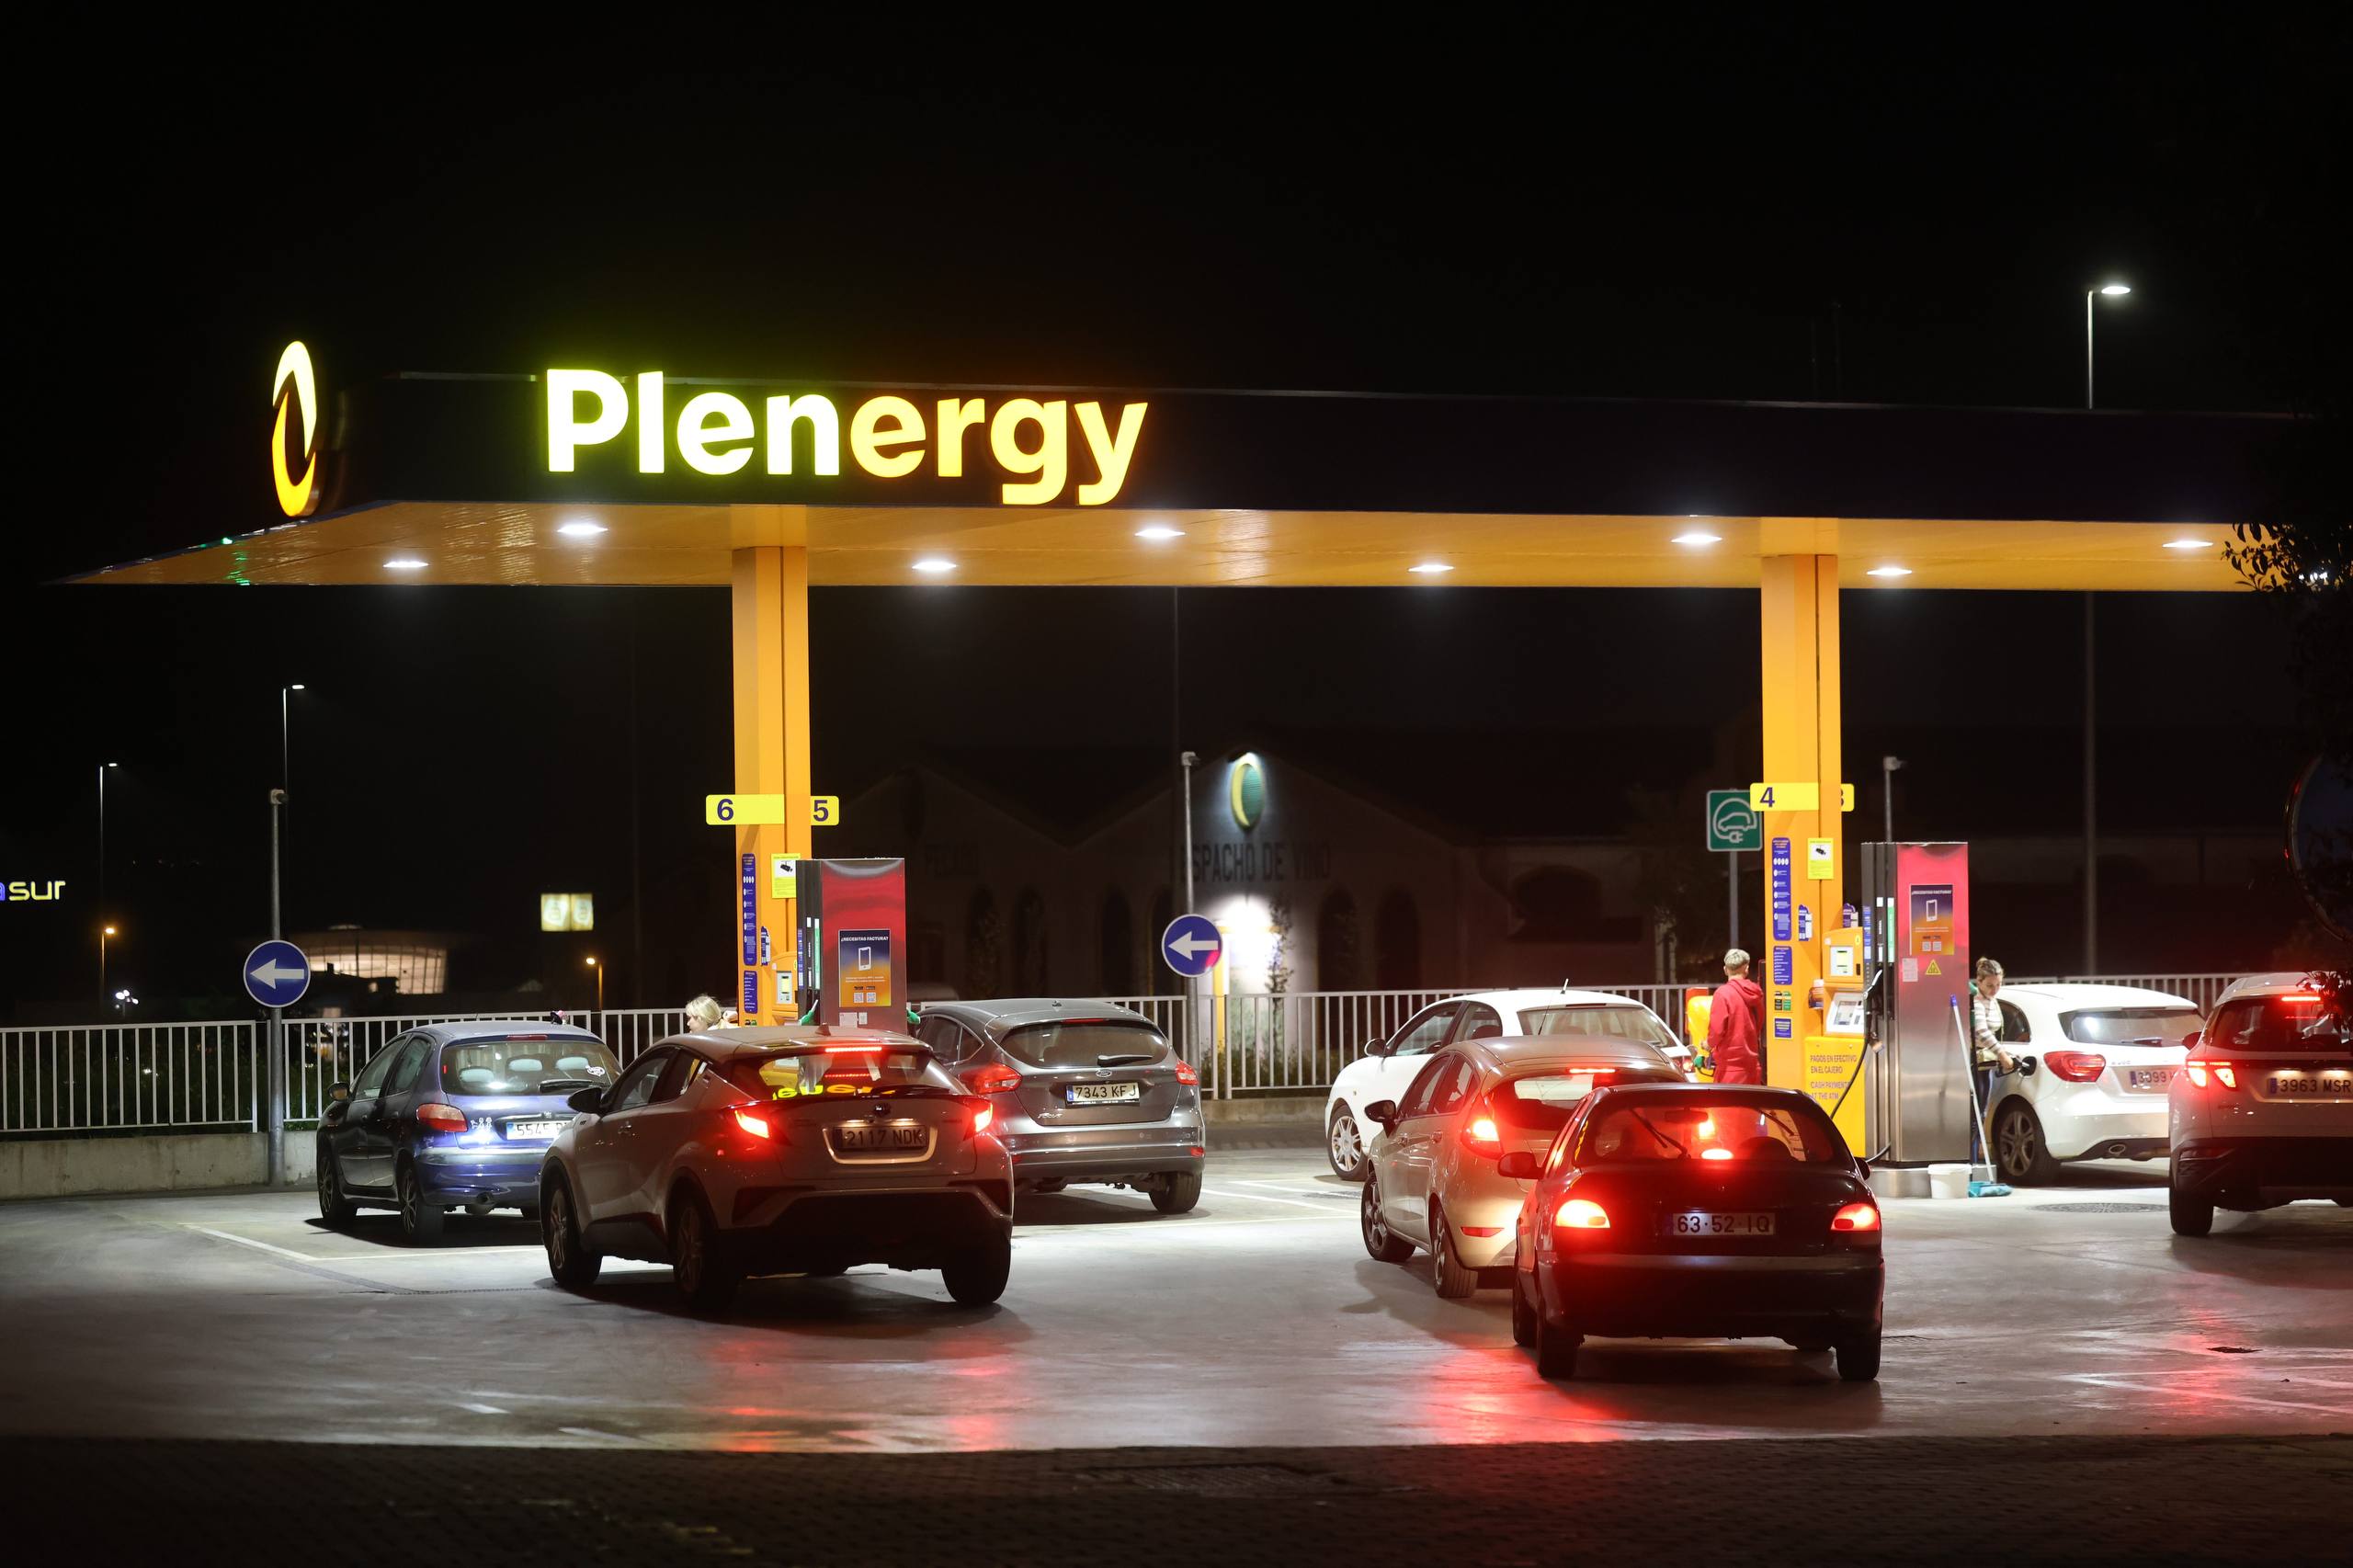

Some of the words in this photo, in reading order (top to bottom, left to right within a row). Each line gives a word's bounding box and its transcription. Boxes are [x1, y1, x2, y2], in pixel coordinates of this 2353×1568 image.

[547, 369, 1148, 506] Plenergy
[1759, 786, 1775, 808] 4
[717, 798, 733, 821] 6
[813, 799, 829, 822] 5
[1262, 840, 1285, 882] DE
[0, 880, 66, 902] sur
[1810, 1054, 1826, 1062] PAGOS
[1834, 1054, 1857, 1062] EFECTIVO
[1824, 1065, 1843, 1074] CAJERO
[1075, 1086, 1108, 1098] 7343
[2279, 1079, 2317, 1092] 3963
[2324, 1079, 2351, 1093] MSR
[847, 1130, 886, 1146] 2117
[892, 1129, 922, 1145] NDK
